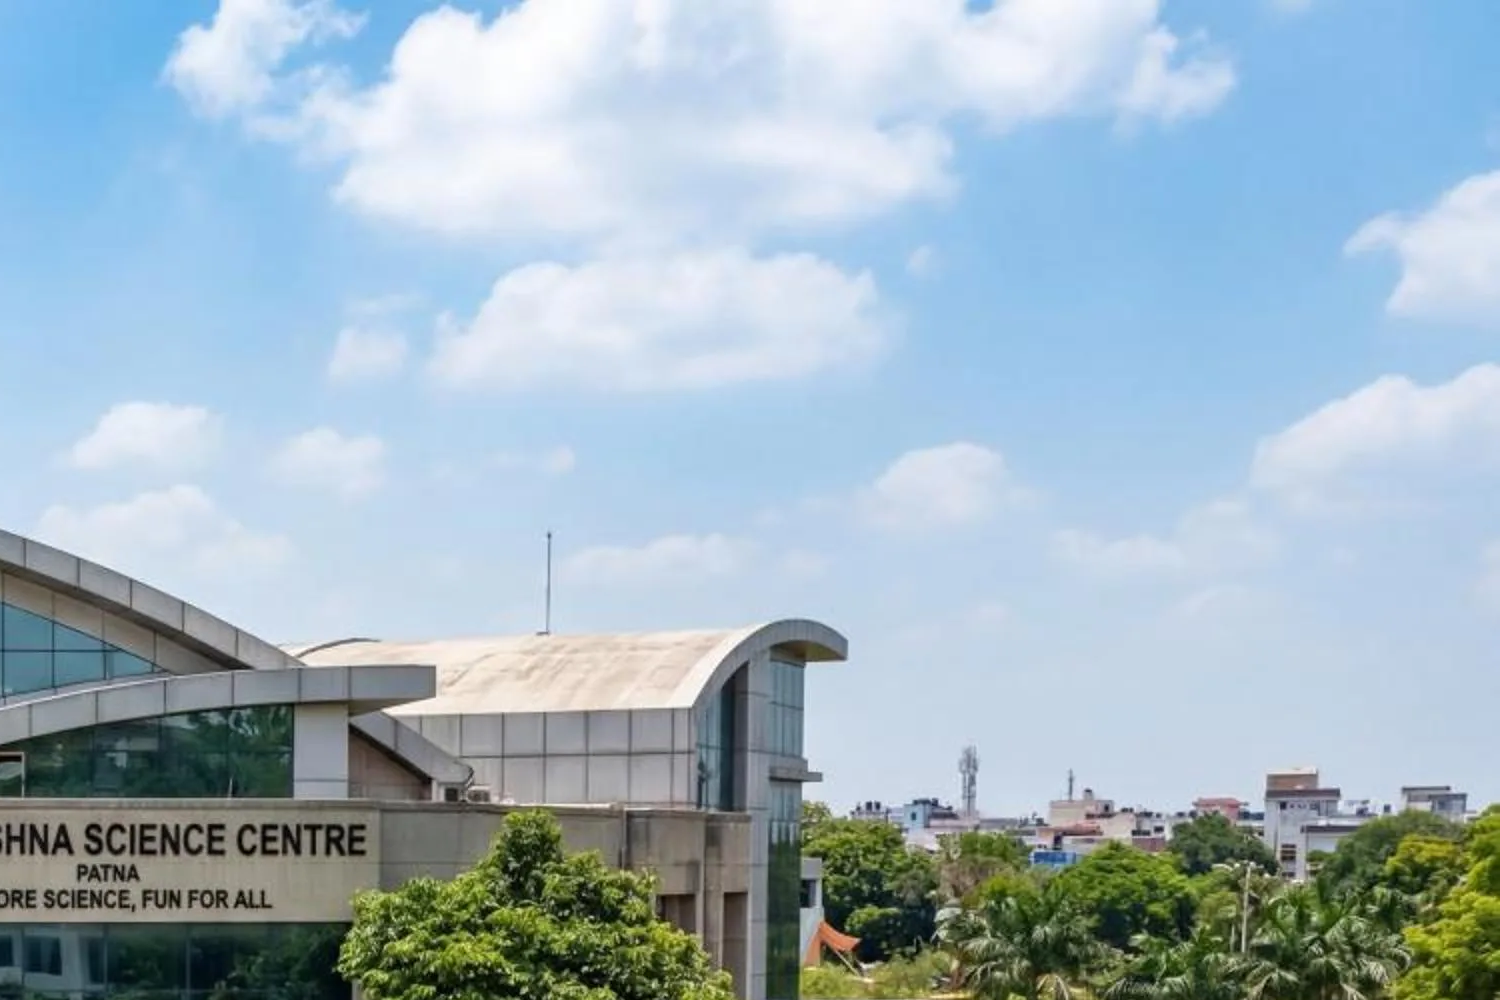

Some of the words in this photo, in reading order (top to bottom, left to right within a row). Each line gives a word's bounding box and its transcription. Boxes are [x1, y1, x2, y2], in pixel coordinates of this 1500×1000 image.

[83, 822, 227, 857] SCIENCE
[236, 822, 368, 857] CENTRE
[76, 863, 141, 883] PATNA
[43, 889, 136, 913] SCIENCE,
[141, 889, 182, 910] FUN
[187, 889, 228, 910] FOR
[233, 889, 273, 910] ALL
